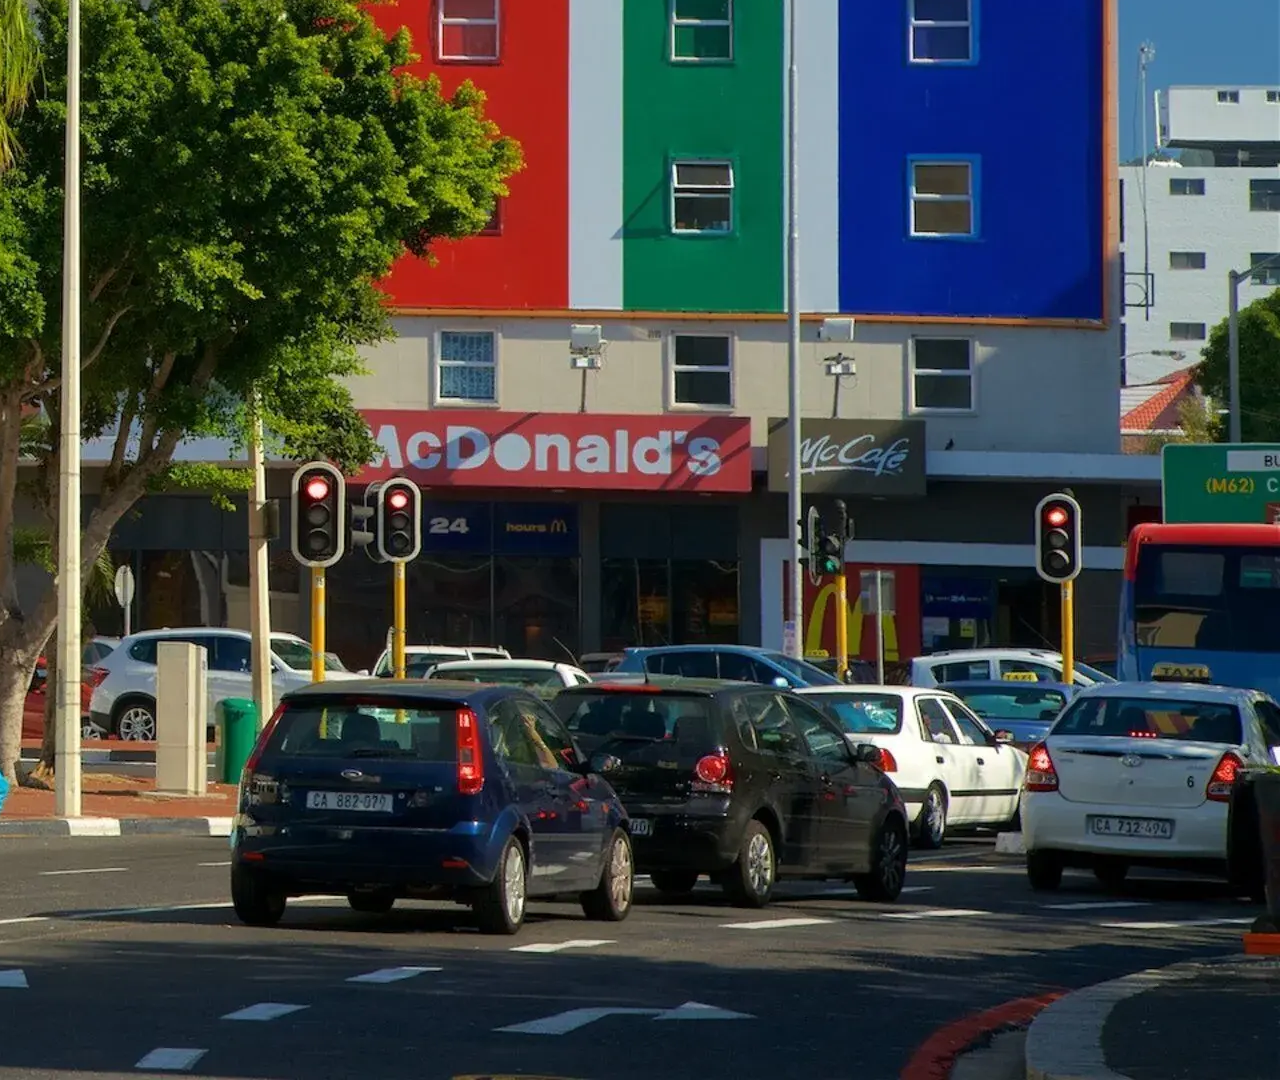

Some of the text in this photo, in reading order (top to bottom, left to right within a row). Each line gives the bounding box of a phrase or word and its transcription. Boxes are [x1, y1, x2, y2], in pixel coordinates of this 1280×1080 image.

[368, 423, 722, 476] McDonald's
[1206, 477, 1255, 494] (M62)
[429, 516, 546, 534] 24 hours
[1006, 673, 1032, 681] TAXI
[1162, 666, 1204, 678] TAXI
[1187, 776, 1195, 788] 6
[313, 793, 327, 808] CA
[1095, 818, 1110, 832] CA
